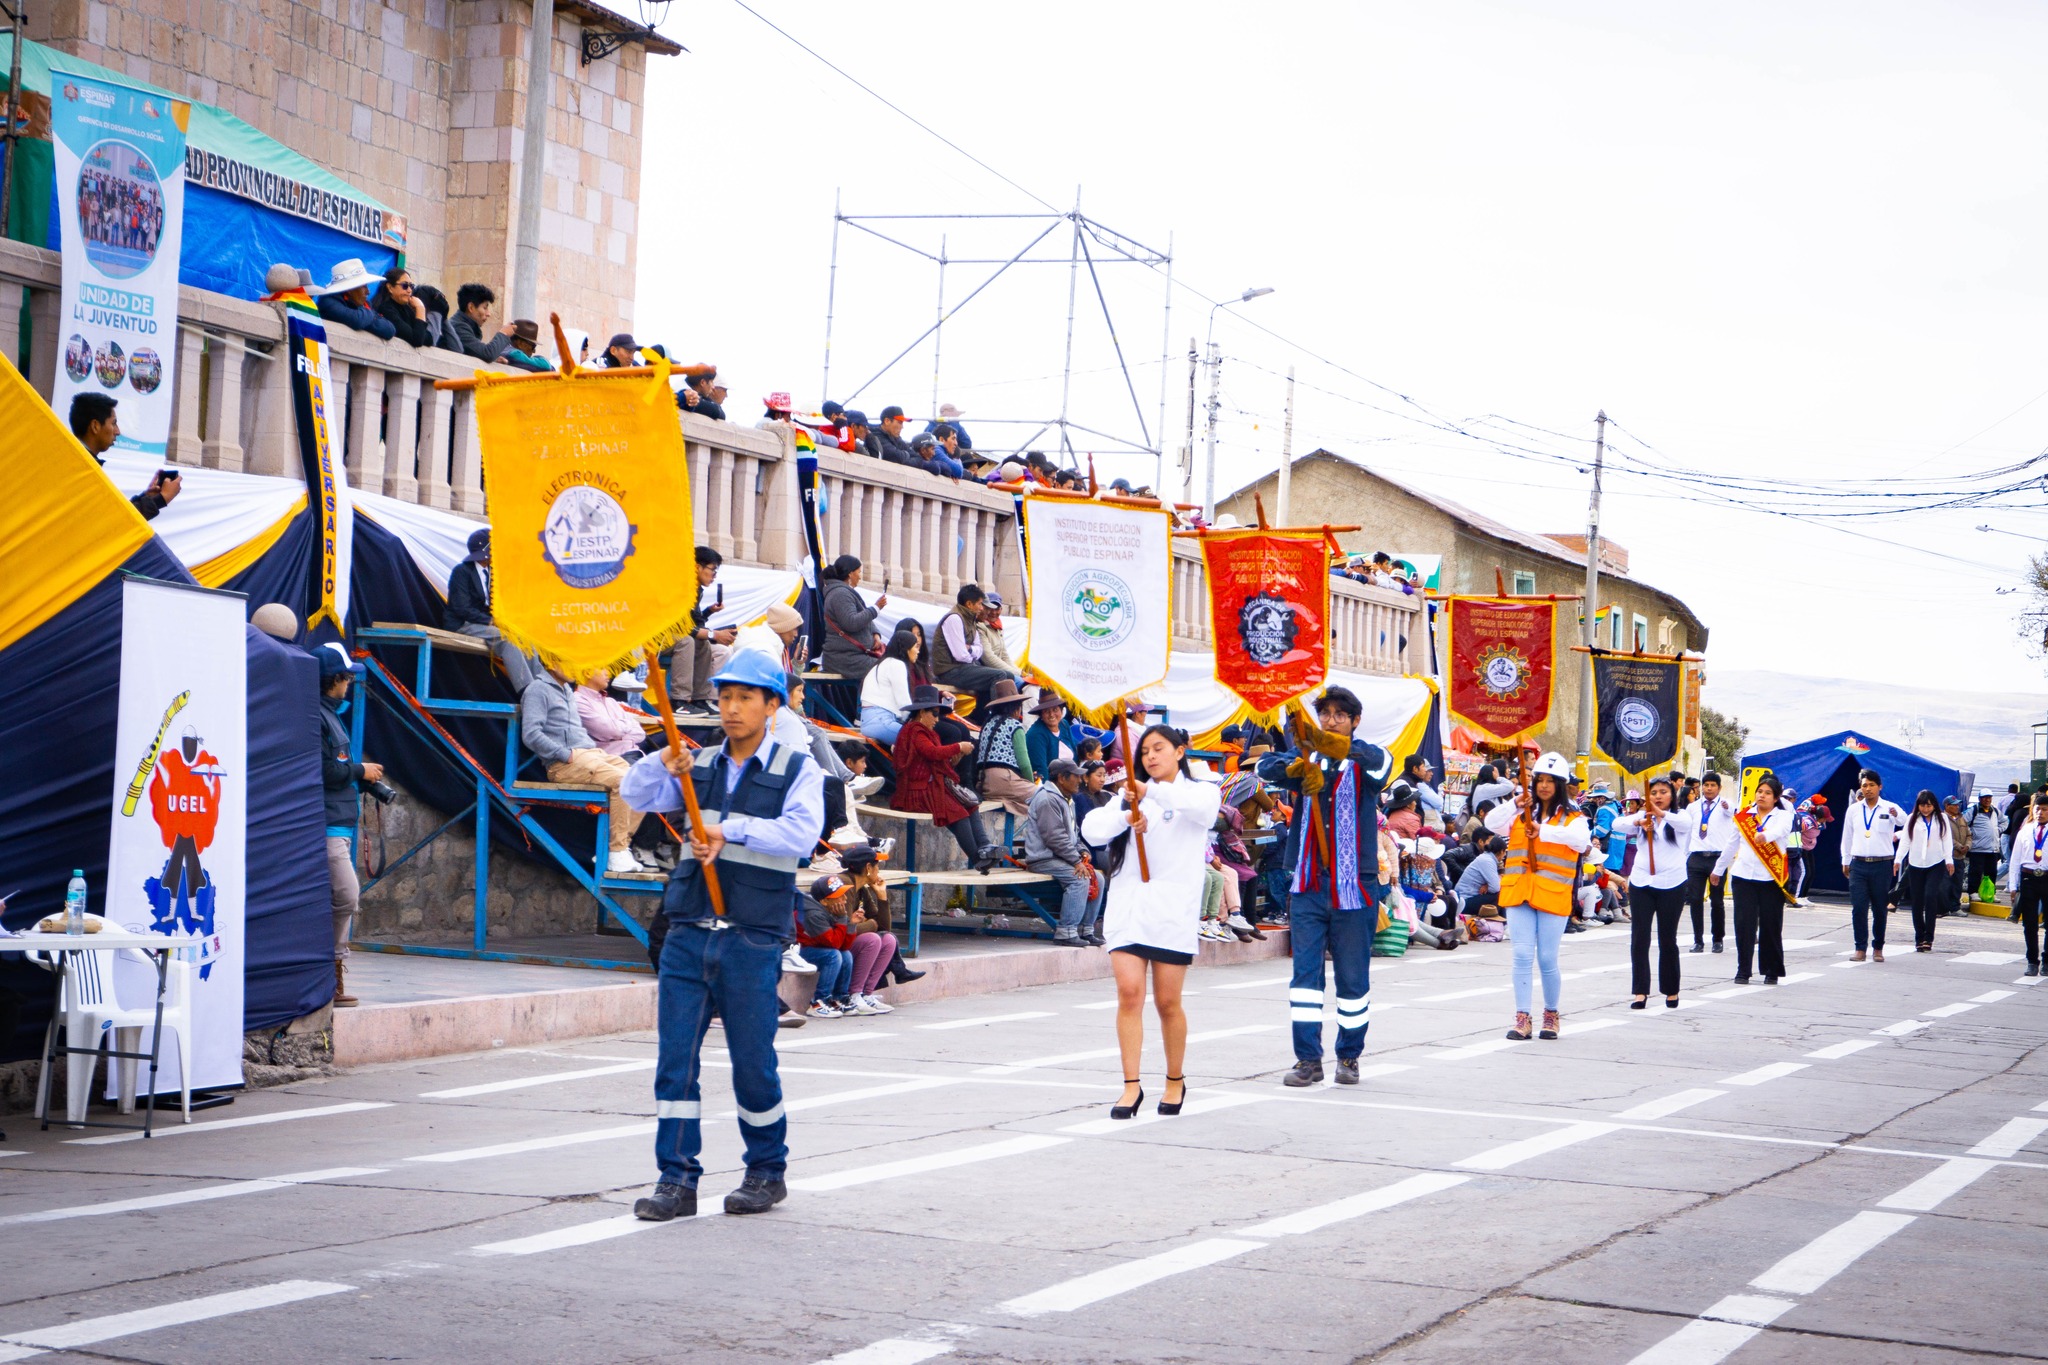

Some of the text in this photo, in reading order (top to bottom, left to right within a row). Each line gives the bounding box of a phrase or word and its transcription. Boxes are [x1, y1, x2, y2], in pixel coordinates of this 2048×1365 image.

[80, 88, 115, 105] ESPINAR
[110, 122, 145, 138] DESARROLLO
[145, 131, 165, 143] SOCIAL
[206, 151, 297, 215] PROVINCIAL
[299, 183, 320, 219] DE
[321, 191, 383, 242] ESPINAR
[80, 283, 151, 314] UNIDAD DE
[74, 303, 157, 335] LA JUVENTUD
[573, 441, 629, 459] ESPINAR
[314, 384, 336, 595] ANIVERSARIO
[541, 470, 628, 506] ELECTRONICA
[1055, 518, 1141, 535] INSTITUTO DE EDUCACION
[576, 535, 611, 548] IESTP
[1057, 531, 1141, 549] SUPERIOR TECNOLOGICO
[572, 547, 620, 560] ESPINAR
[1063, 545, 1134, 561] PUBLICO ESPINAR
[1256, 550, 1264, 559] DE
[561, 571, 617, 589] INDUSTRIAL
[1092, 572, 1132, 619] AGROPECUARIA
[550, 601, 631, 617] ELECTRONICA
[1495, 611, 1503, 619] DE
[555, 620, 626, 635] INDUSTRIAL
[1500, 630, 1529, 639] ESPINAR
[1090, 633, 1121, 648] ESPINAR
[1277, 672, 1287, 681] DE
[1634, 683, 1659, 691] ESPINAR
[1479, 704, 1527, 715] OPERACIONES
[1487, 714, 1518, 723] MINERAS
[1622, 716, 1647, 725] APSTI
[1626, 750, 1647, 760] APSTI
[168, 794, 208, 814] UGEL
